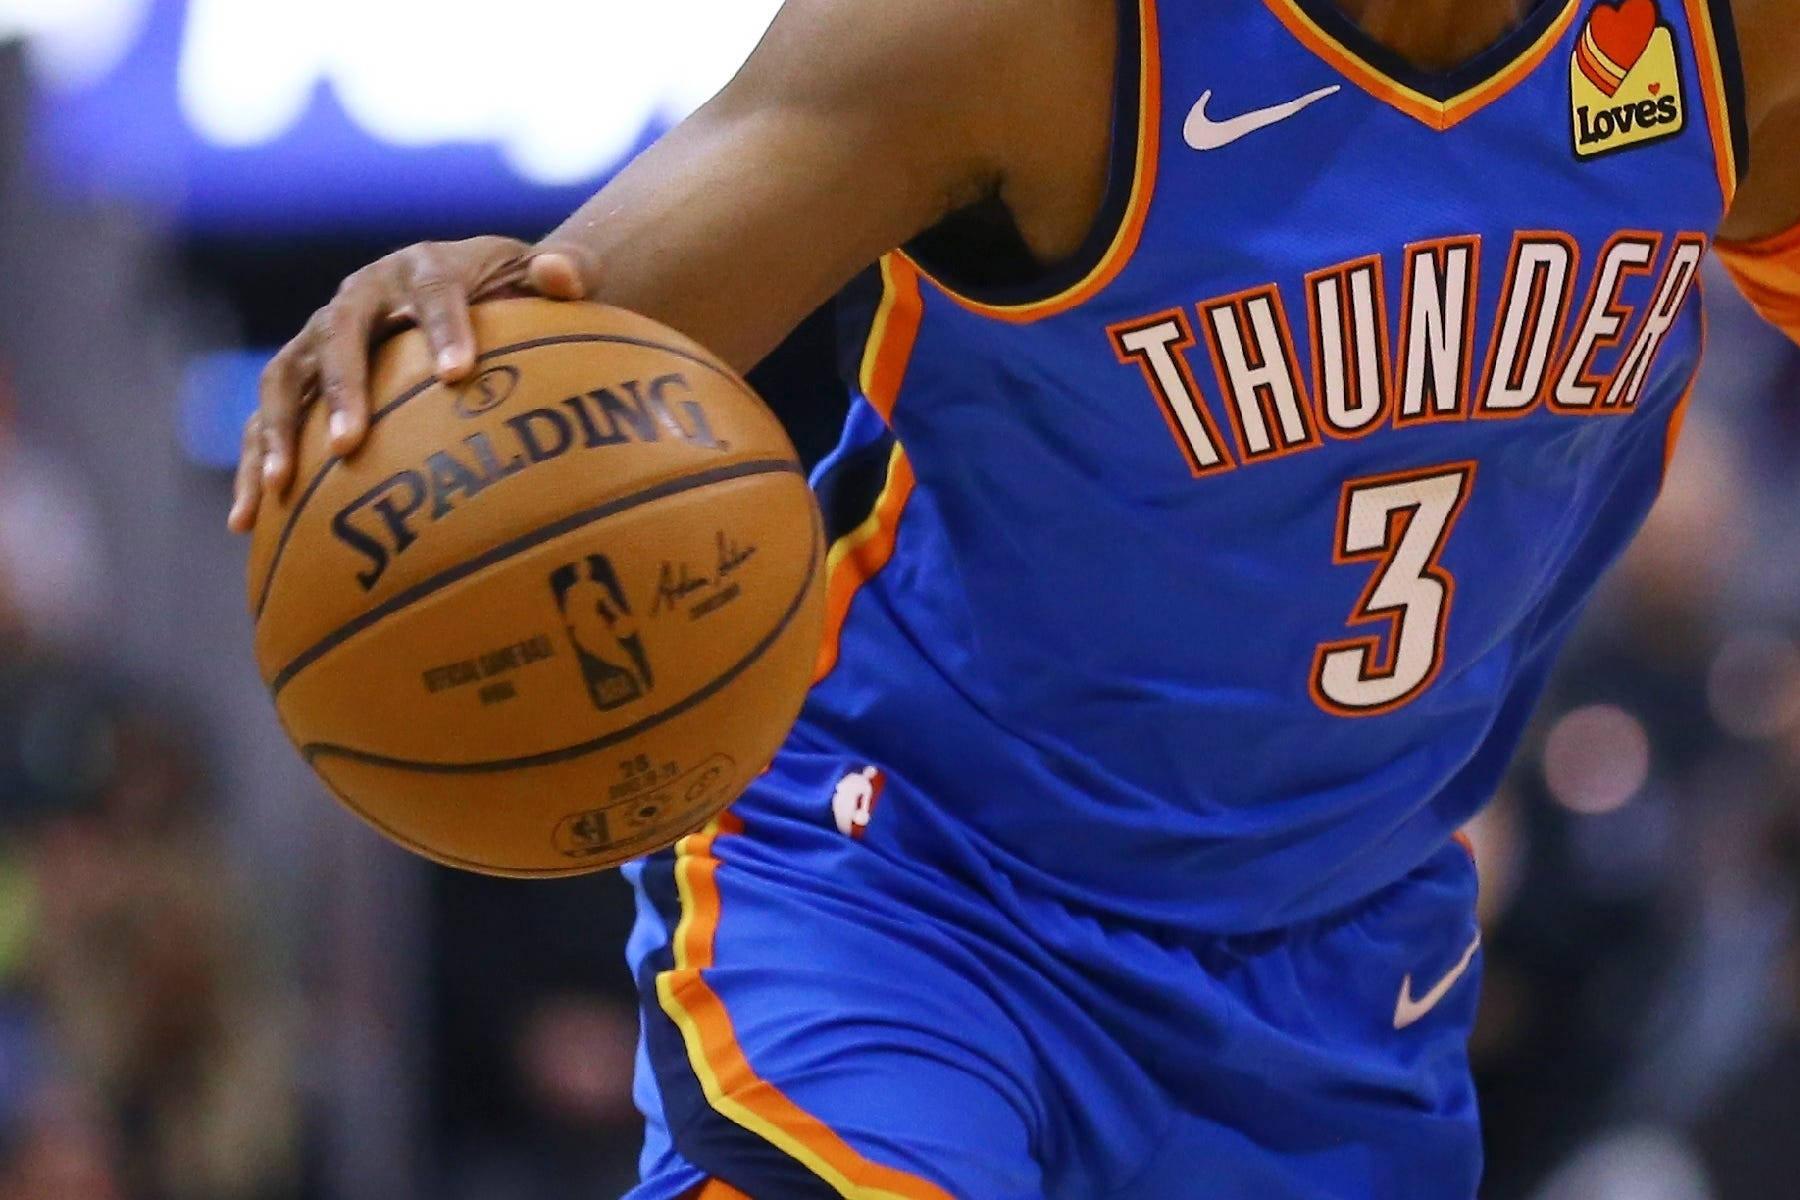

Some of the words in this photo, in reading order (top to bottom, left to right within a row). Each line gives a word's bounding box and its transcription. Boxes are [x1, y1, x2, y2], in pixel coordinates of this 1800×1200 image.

[1106, 230, 1707, 478] THUNDER
[331, 373, 730, 592] SPALDING
[1308, 460, 1478, 717] 3
